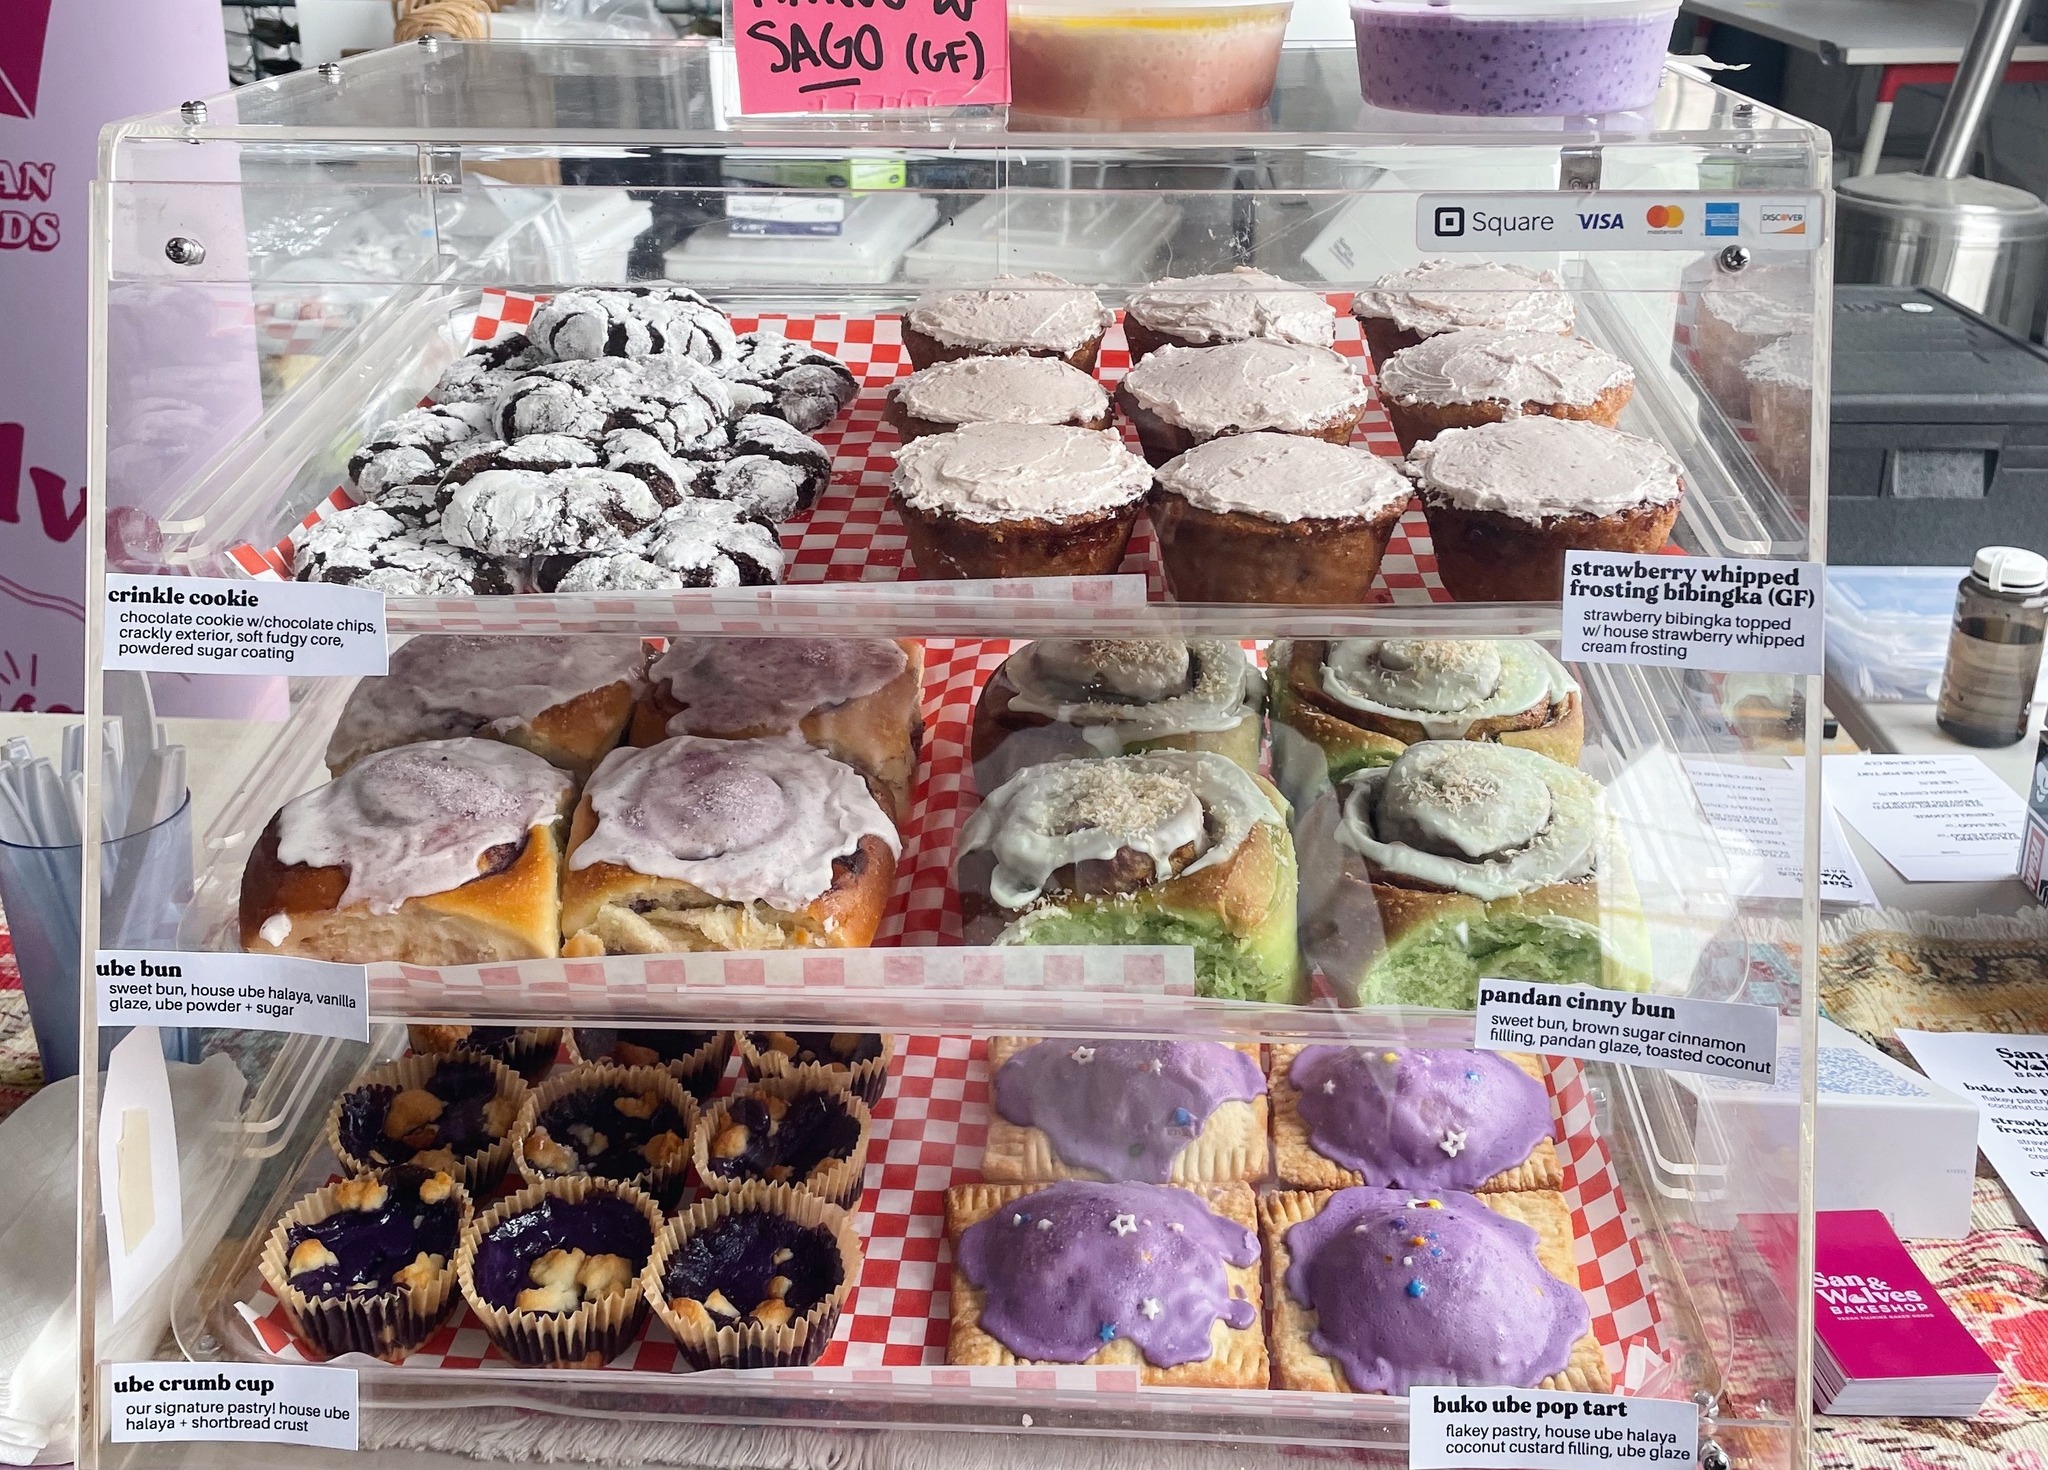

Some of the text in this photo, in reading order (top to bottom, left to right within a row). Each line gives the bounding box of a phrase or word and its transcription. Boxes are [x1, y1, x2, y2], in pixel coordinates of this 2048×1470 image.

[746, 20, 985, 80] SAGO (GF)
[1472, 211, 1555, 236] Square
[1575, 213, 1625, 230] VISA
[1762, 213, 1804, 222] DISCOVER
[1571, 561, 1799, 588] strawberry whipped
[108, 585, 259, 607] crinkle cookie
[1570, 580, 1815, 609] frosting bibingka (GF)
[120, 611, 377, 634] chocolate cookie w/chocolate chips,
[1583, 609, 1791, 631] strawberry bibingka topped
[119, 627, 344, 647] crackly exterior, soft fudgy core,
[1583, 624, 1805, 648] w/ house strawberry whipped
[119, 642, 295, 662] powdered sugar coating
[1582, 642, 1687, 660] cream frosting
[95, 959, 182, 977] ube bun
[109, 983, 356, 1008] sweet bun, house ube halaya, vanilla
[1480, 987, 1676, 1019] pandan cinny bun
[109, 998, 294, 1017] glaze, ube powder + sugar
[1491, 1015, 1746, 1053] sweet bun, brown sugar cinnamon
[1539, 1034, 1595, 1051] pandan
[1599, 1039, 1641, 1056] glaze,
[1646, 1044, 1701, 1062] toasted
[1706, 1053, 1772, 1074] coconut
[1963, 1082, 2005, 1093] buko
[2007, 1086, 2038, 1095] ube
[1866, 1276, 1892, 1291] &
[1828, 1303, 1929, 1315] BAKESHOP
[113, 1373, 275, 1395] ube crumb cup
[126, 1401, 350, 1420] our signature pastry! house ube
[1433, 1395, 1627, 1419] buko ube pop tart
[126, 1416, 308, 1432] halaya + shortbread crust
[1446, 1424, 1676, 1446] flakey pastry, house ube halaya
[1446, 1441, 1690, 1460] coconut custard filling, ube glaze
